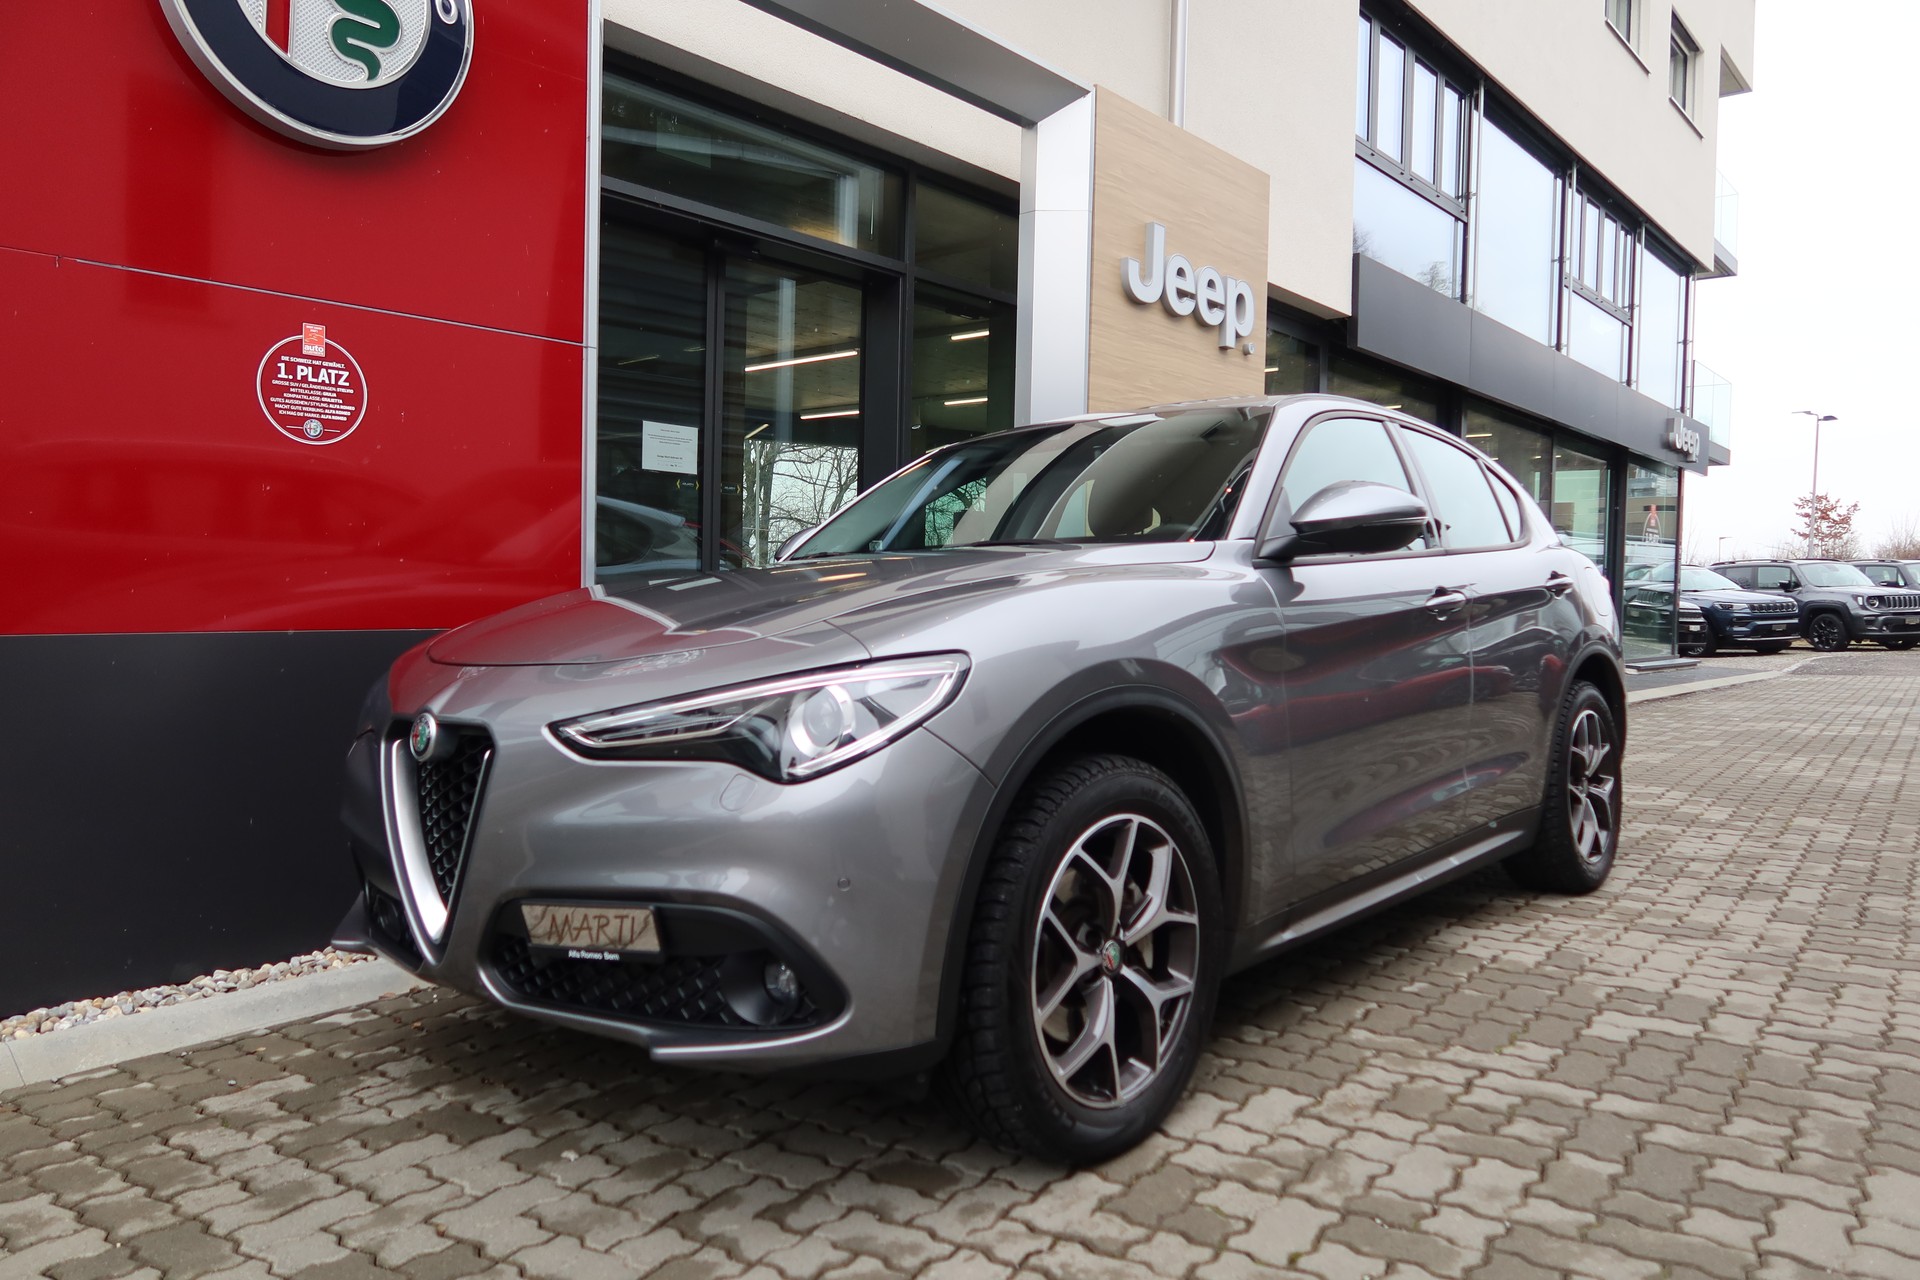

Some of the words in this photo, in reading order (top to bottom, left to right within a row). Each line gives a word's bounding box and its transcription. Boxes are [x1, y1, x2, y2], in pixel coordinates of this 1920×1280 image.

[1120, 221, 1255, 350] Jeep
[290, 357, 313, 365] SCHWEIZ
[304, 345, 324, 353] auto
[277, 362, 294, 380] 1.
[296, 364, 350, 387] PLATZ
[1669, 417, 1700, 462] Jeep
[548, 913, 635, 946] MARTI
[568, 950, 580, 960] Alfa
[580, 950, 602, 961] Romeo
[604, 951, 620, 961] Bern
